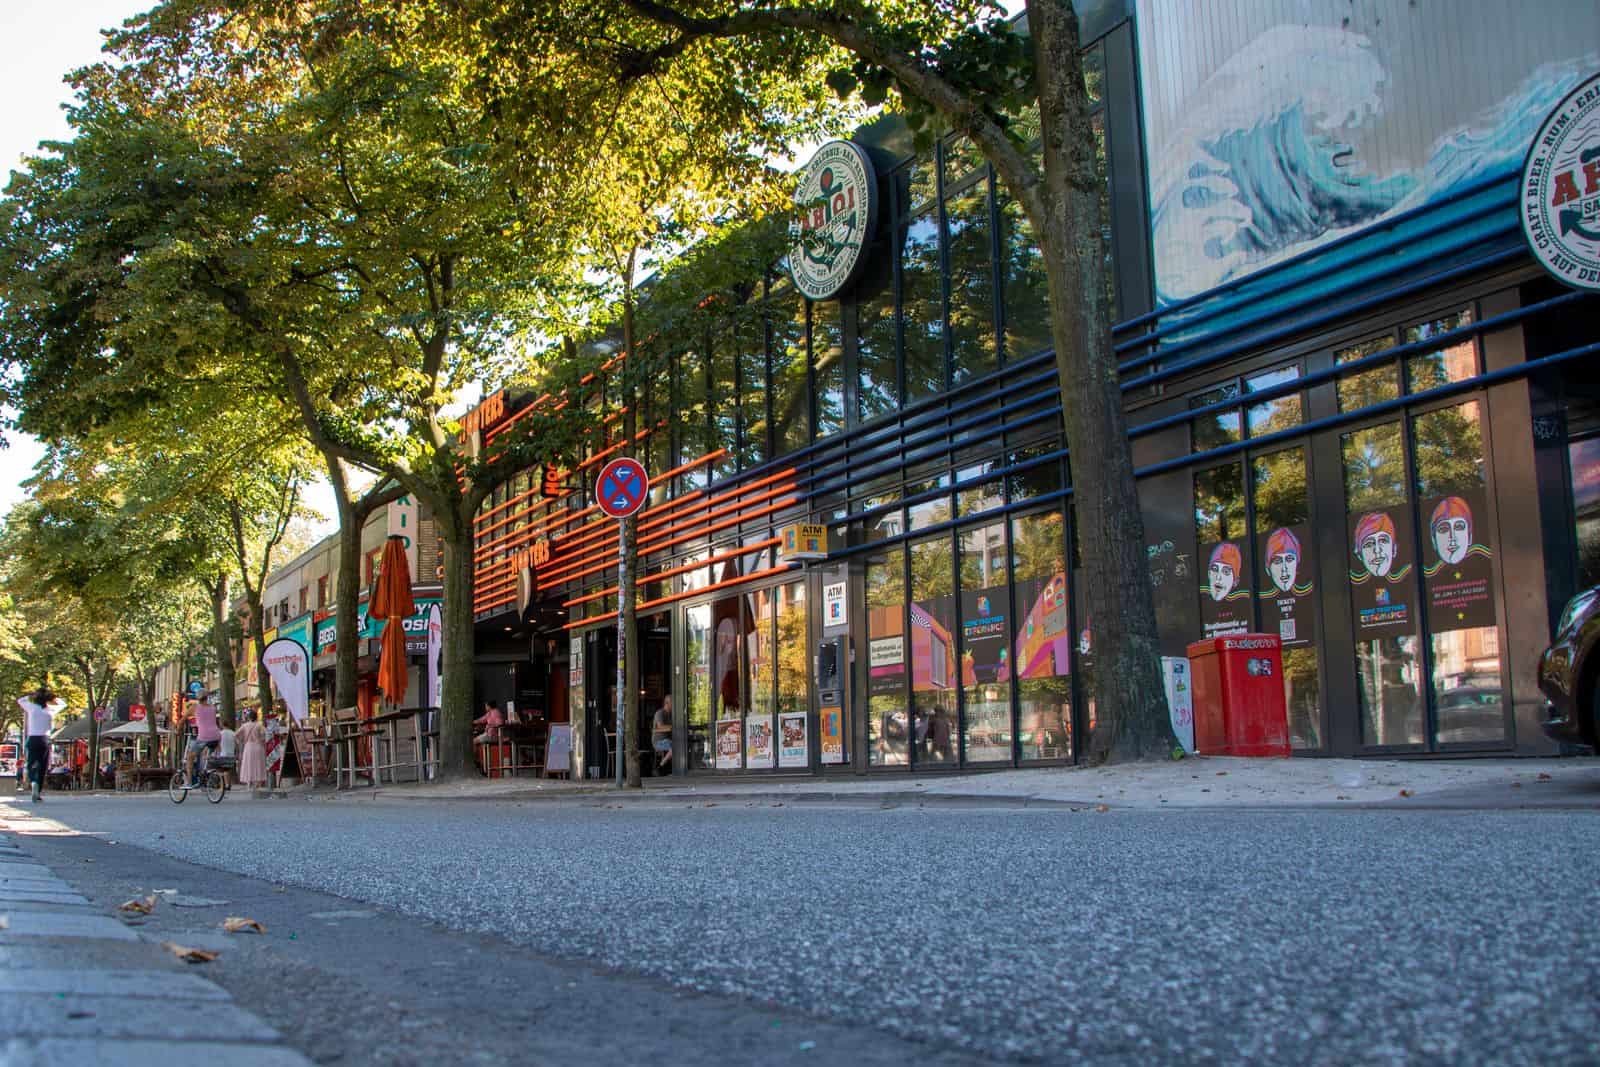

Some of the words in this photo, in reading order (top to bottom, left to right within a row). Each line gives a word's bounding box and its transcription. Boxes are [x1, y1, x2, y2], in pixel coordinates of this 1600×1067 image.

[1543, 113, 1570, 147] RUM
[1528, 158, 1545, 197] BEER
[1528, 203, 1549, 249] CRAFT
[1549, 253, 1576, 274] AUF
[802, 525, 822, 534] ATM
[828, 586, 843, 597] ATM
